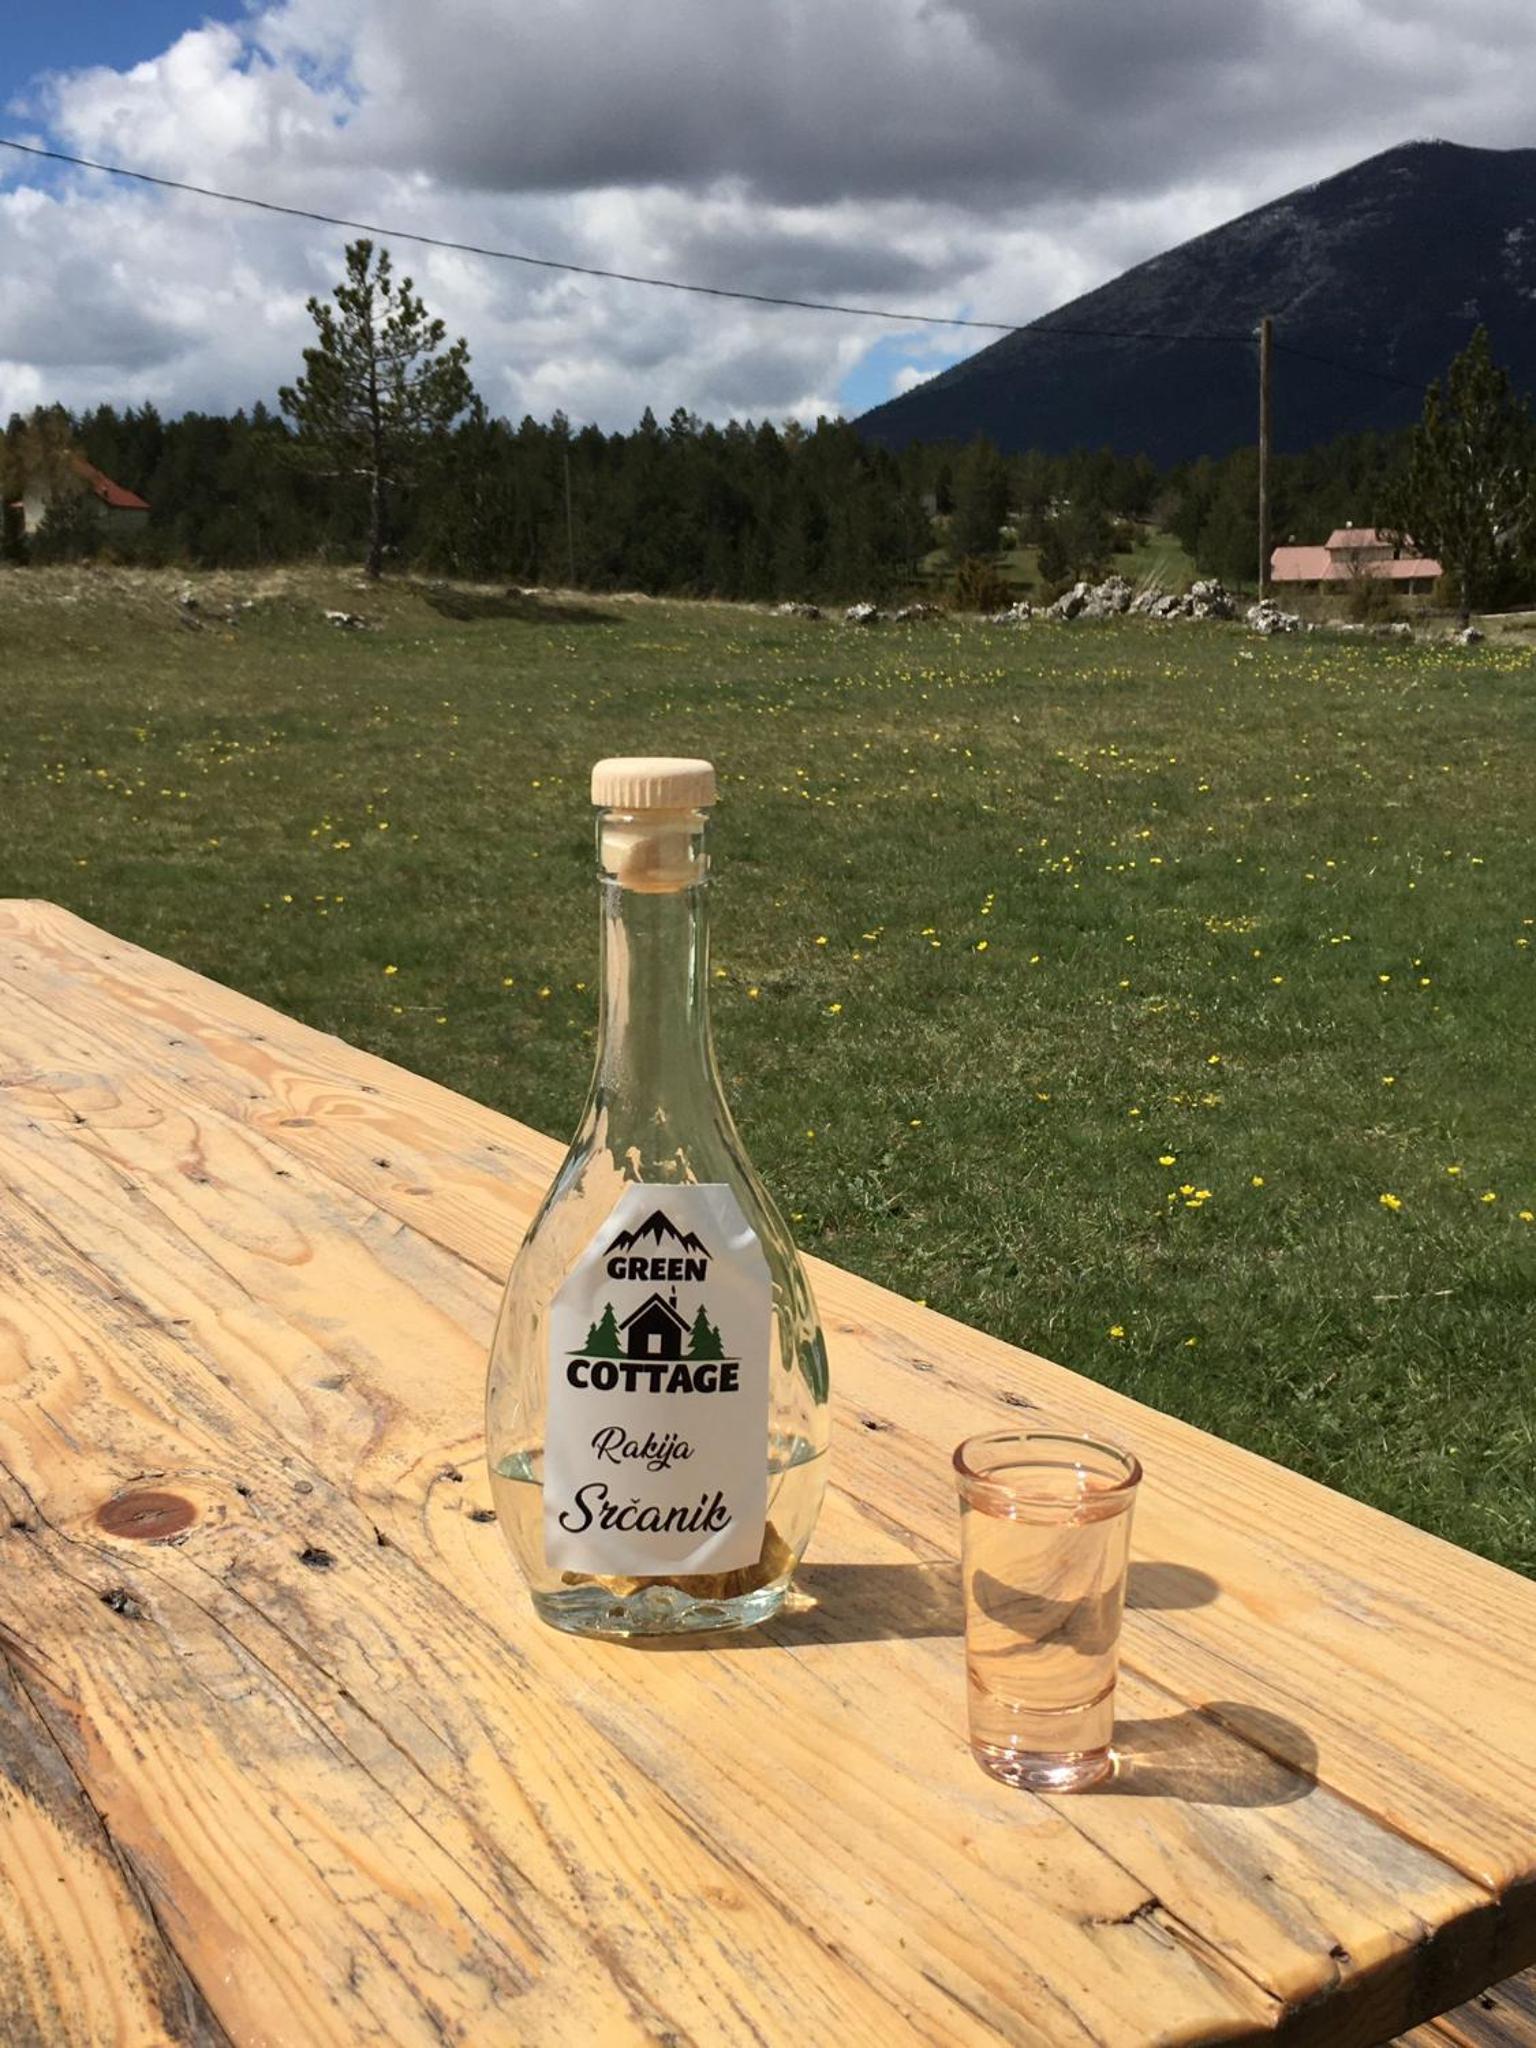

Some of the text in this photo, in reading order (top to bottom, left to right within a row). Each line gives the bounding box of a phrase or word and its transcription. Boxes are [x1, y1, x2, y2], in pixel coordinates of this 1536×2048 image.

[607, 1257, 708, 1281] GREEN
[566, 1360, 740, 1394] COTTAGE
[591, 1426, 695, 1472] Rakija
[558, 1482, 733, 1534] Srčanik
